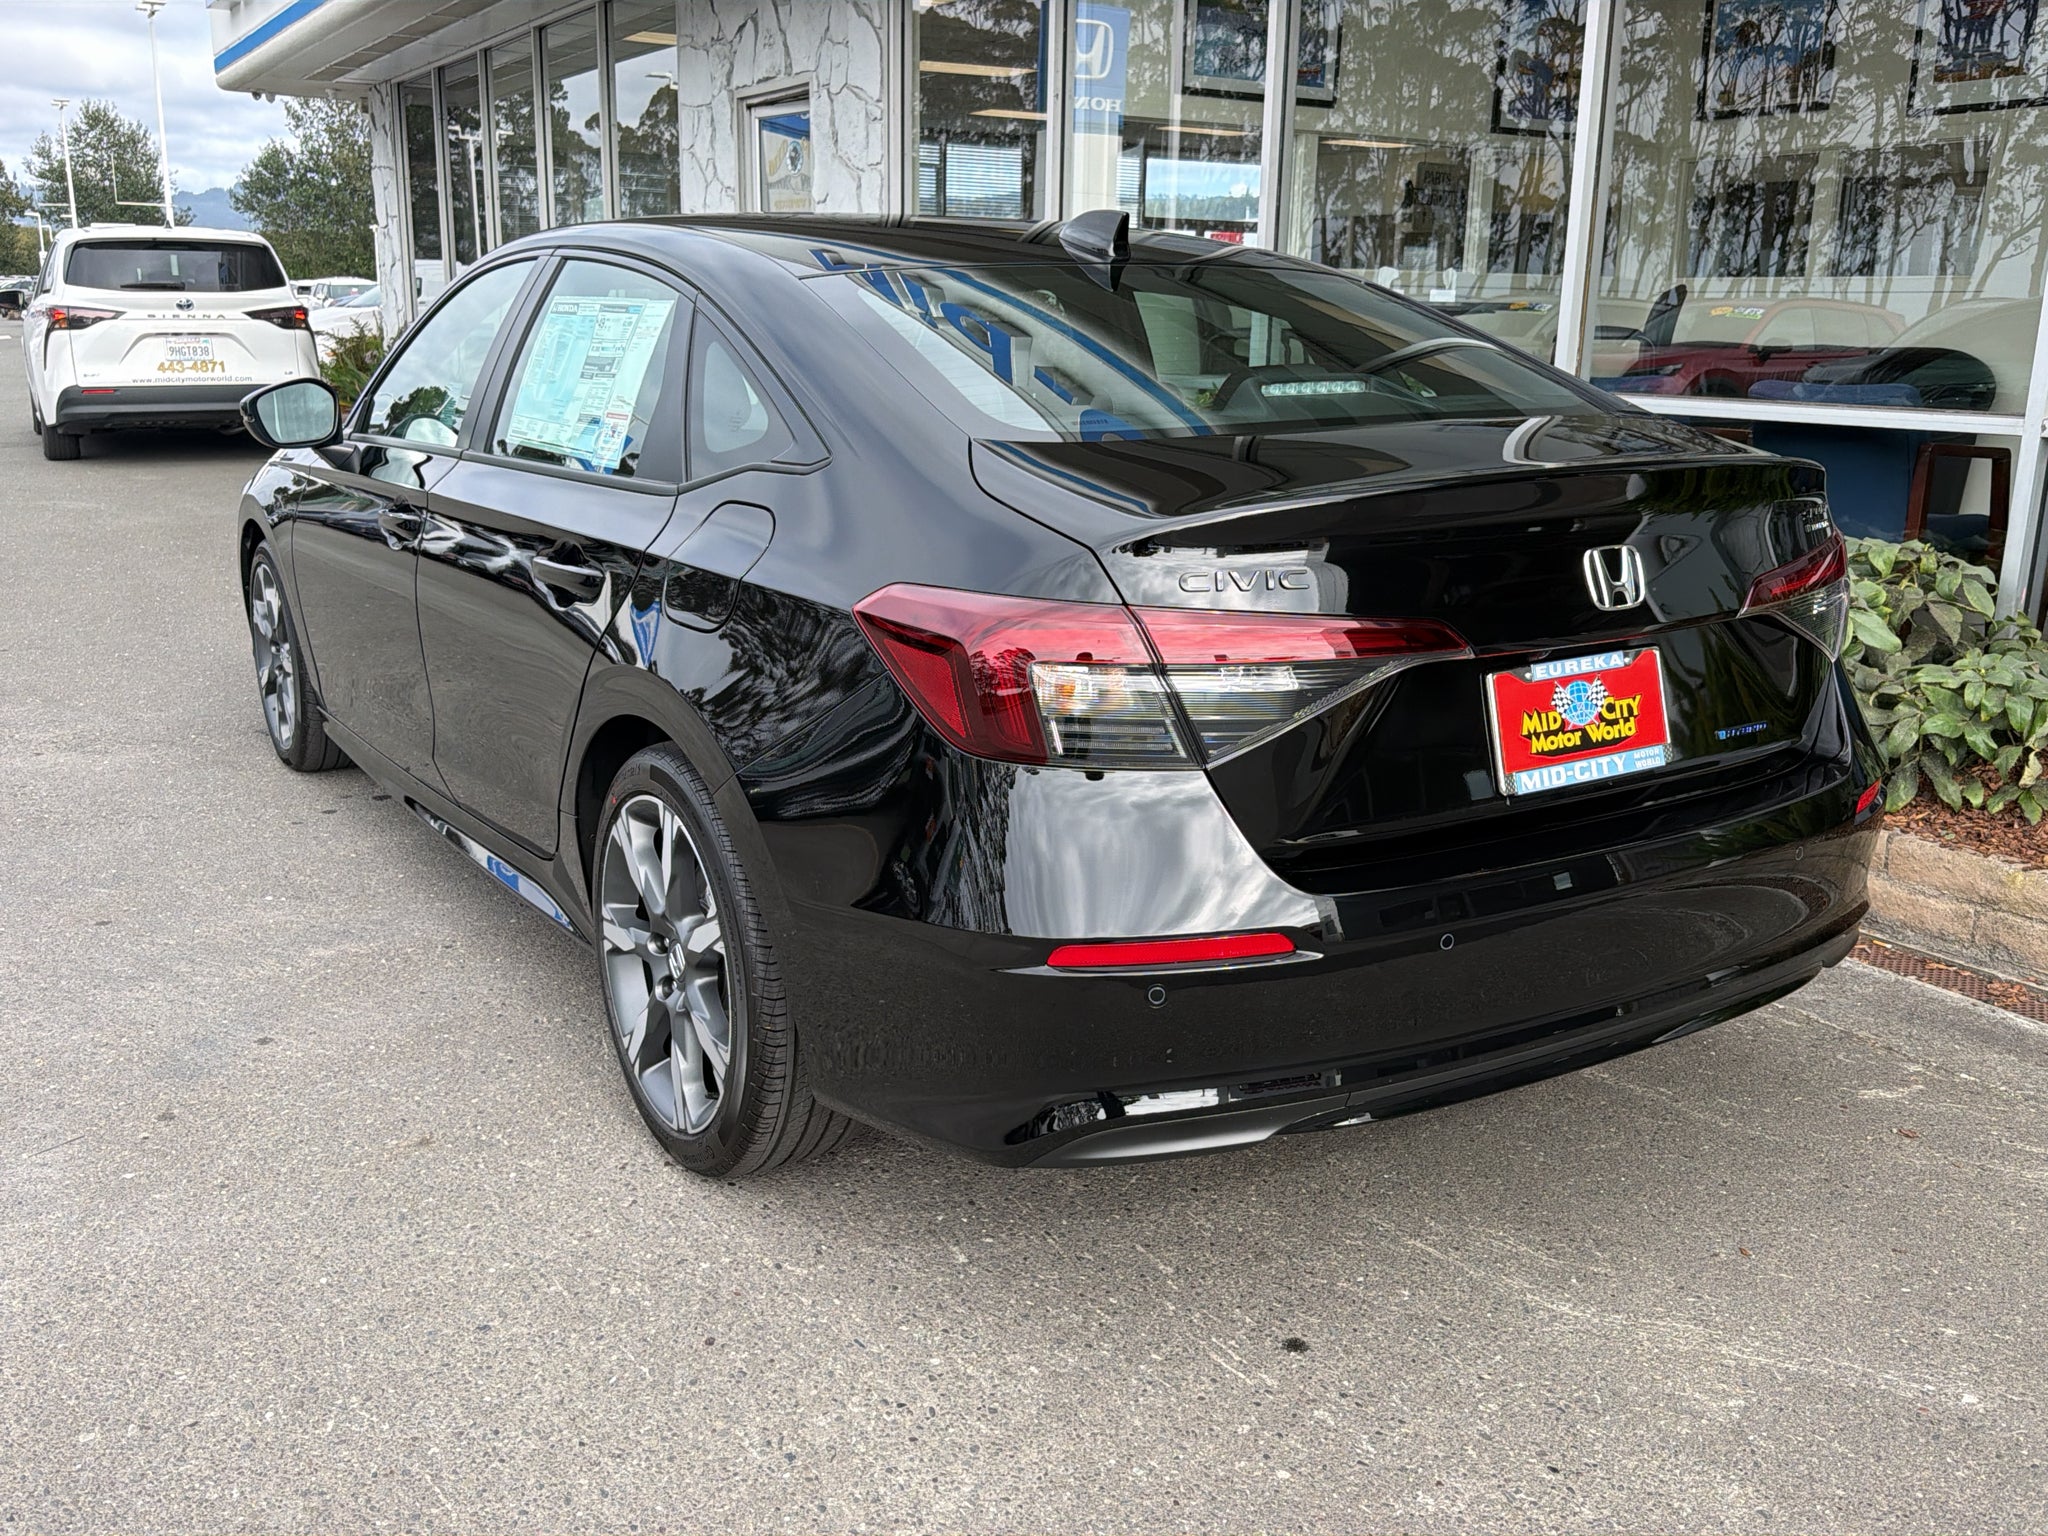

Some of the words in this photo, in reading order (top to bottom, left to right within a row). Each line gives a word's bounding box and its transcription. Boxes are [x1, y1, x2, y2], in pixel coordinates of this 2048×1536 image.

[168, 345, 210, 357] 9HGT838
[157, 360, 226, 374] 443-4871
[131, 375, 253, 384] www.midcitymotorworld.com
[1178, 569, 1310, 593] CIVIC
[1535, 651, 1624, 679] EUREKA
[1531, 730, 1583, 755] Motor
[1584, 716, 1637, 744] World
[1634, 748, 1660, 760] MOTOR
[1634, 757, 1661, 769] WORLD
[1520, 755, 1627, 791] MID-CITY
